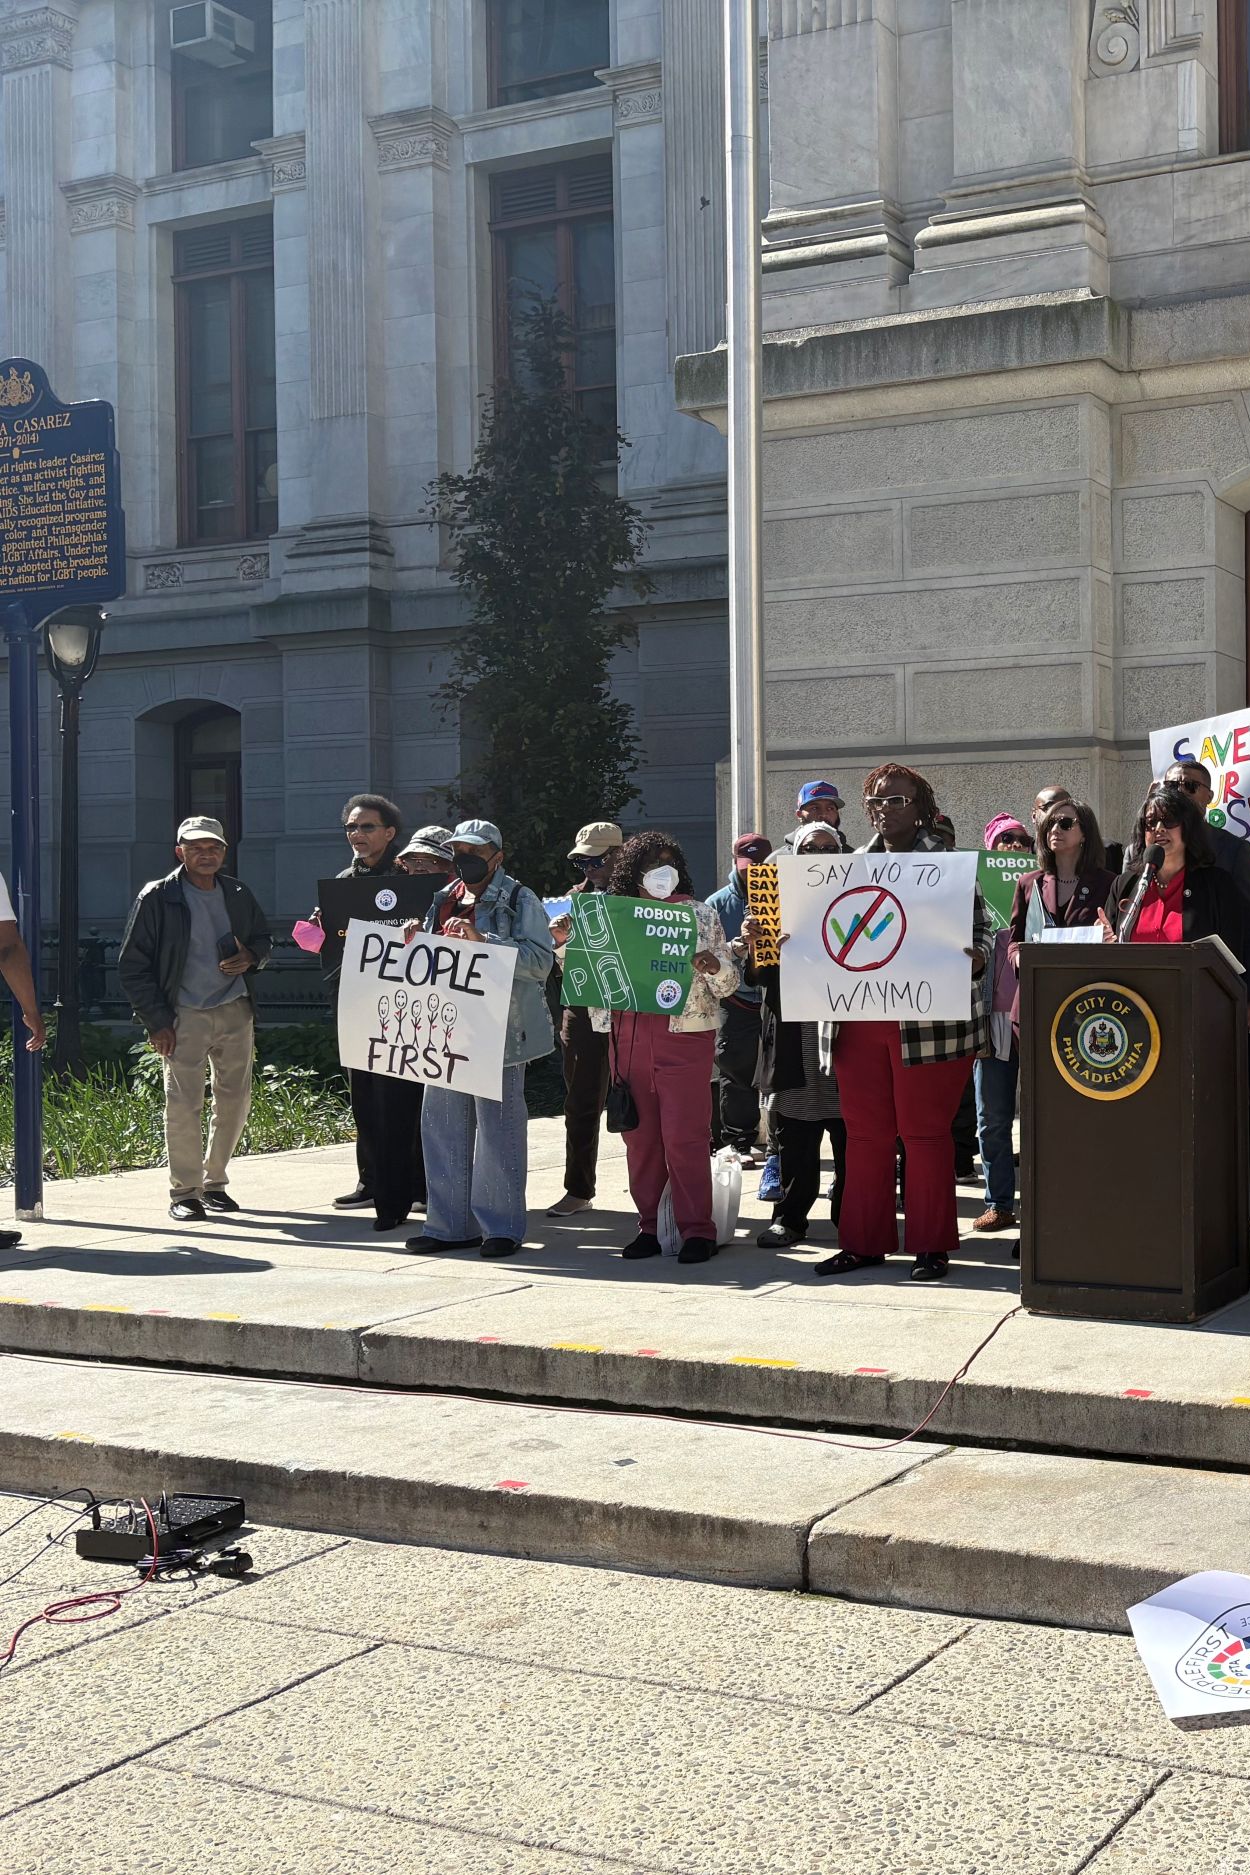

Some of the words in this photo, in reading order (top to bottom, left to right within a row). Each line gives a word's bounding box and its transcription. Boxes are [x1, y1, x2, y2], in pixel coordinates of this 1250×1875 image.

[14, 413, 71, 433] CASAREZ
[11, 461, 37, 473] rights
[39, 456, 67, 468] leader
[70, 453, 105, 464] Casarez
[10, 475, 21, 484] as
[22, 473, 33, 482] an
[34, 467, 67, 481] activist
[70, 463, 105, 477] fighting
[0, 486, 20, 496] tice,
[23, 481, 56, 493] welfare
[89, 473, 106, 485] and
[18, 494, 34, 505] She
[36, 491, 50, 503] led
[52, 490, 67, 501] the
[69, 488, 86, 499] Gay
[88, 485, 106, 496] and
[17, 513, 64, 527] recognized
[65, 510, 107, 524] programs
[20, 502, 62, 516] Education
[4, 529, 27, 540] color
[31, 526, 48, 537] and
[52, 520, 107, 534] transgender
[2, 538, 46, 553] appointed
[47, 530, 107, 546] Philadelphia's
[3, 550, 26, 563] LGBT
[28, 548, 61, 560] Affairs.
[64, 545, 90, 556] Under
[92, 543, 108, 553] her
[16, 560, 52, 574] adopted
[53, 558, 68, 569] the
[69, 554, 109, 567] broadest
[8, 574, 36, 585] nation
[37, 572, 50, 582] for
[52, 568, 76, 581] LGBT
[77, 565, 109, 580] people.
[1173, 725, 1250, 768] SAVE
[750, 868, 778, 878] SAY
[807, 862, 853, 888] SAY
[870, 862, 901, 885] NO
[912, 863, 941, 887] TO
[750, 880, 778, 891] SAY
[750, 893, 779, 903] SAY
[634, 906, 691, 923] ROBOTS
[751, 905, 779, 916] SAY
[645, 924, 692, 939] DON'T
[661, 943, 689, 957] PAY
[359, 933, 488, 996] PEOPLE
[650, 960, 687, 974] RENT
[826, 980, 932, 1014] WAYMO
[1075, 996, 1106, 1014] CITY
[1111, 1000, 1131, 1015] OF
[367, 1037, 470, 1084] FIRST
[1063, 1037, 1143, 1083] PHILADELPHIA
[1185, 1622, 1229, 1667] FIRST
[1229, 1658, 1248, 1677] PFTA
